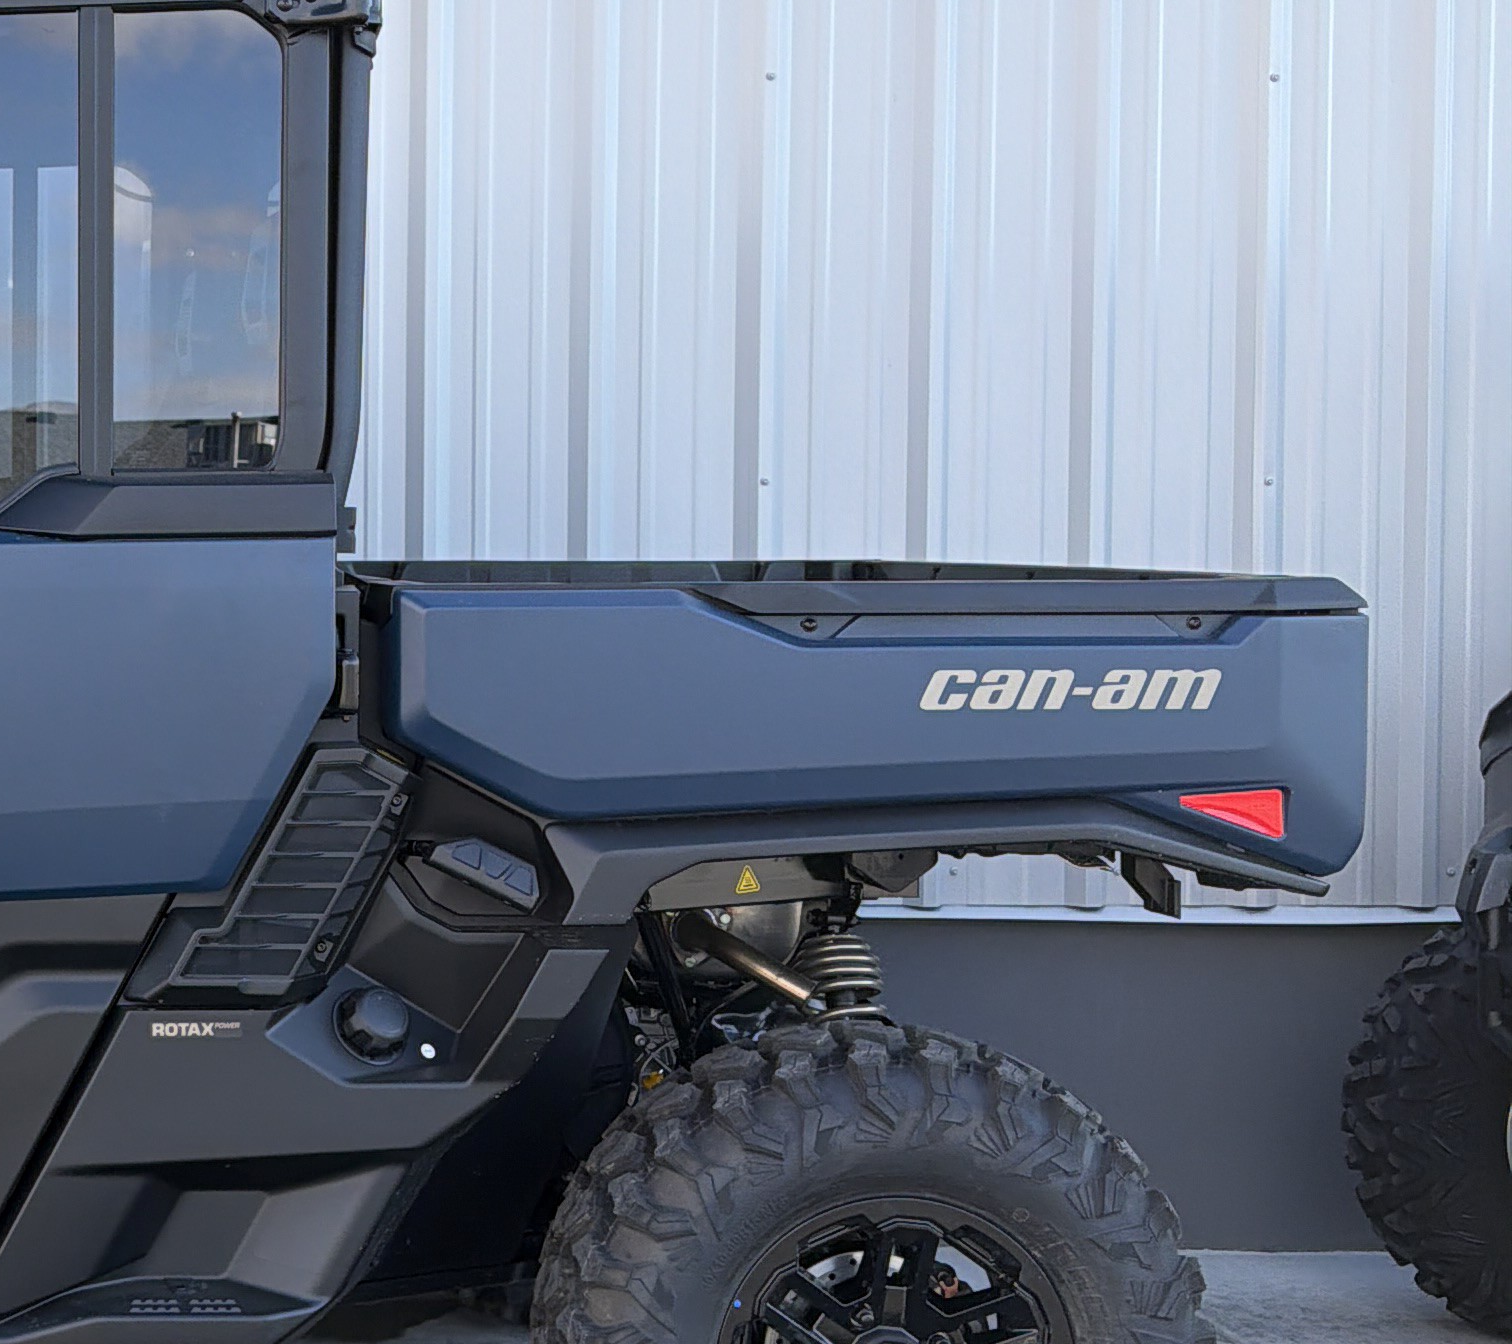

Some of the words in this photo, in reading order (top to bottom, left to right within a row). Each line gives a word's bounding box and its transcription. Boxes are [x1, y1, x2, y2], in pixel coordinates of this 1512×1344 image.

[919, 668, 1223, 711] can-am
[151, 1022, 214, 1037] ROTAX
[214, 1021, 241, 1030] POWER
